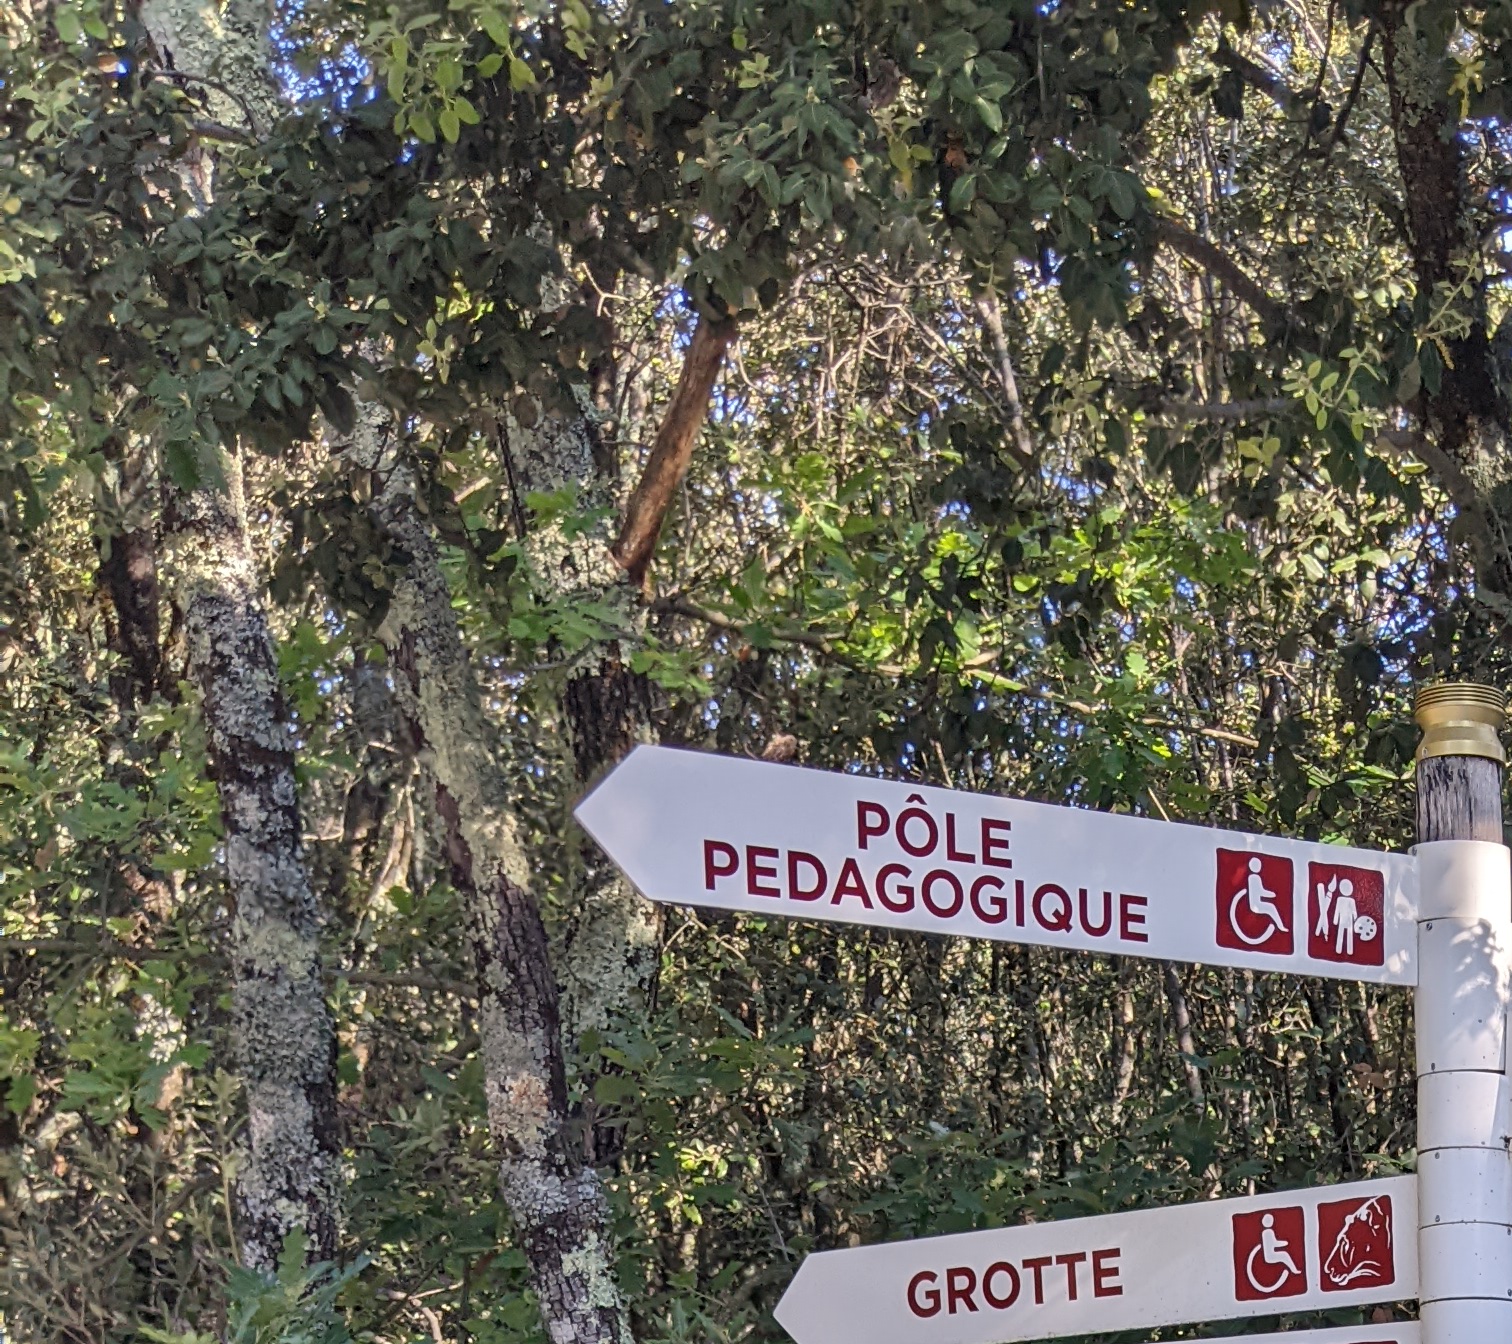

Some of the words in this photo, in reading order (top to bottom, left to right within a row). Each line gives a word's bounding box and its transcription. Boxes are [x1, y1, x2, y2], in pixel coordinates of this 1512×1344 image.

[857, 794, 1012, 868] PÔLE
[704, 839, 1148, 942] PEDAGOGIQUE
[907, 1247, 1123, 1318] GROTTE
